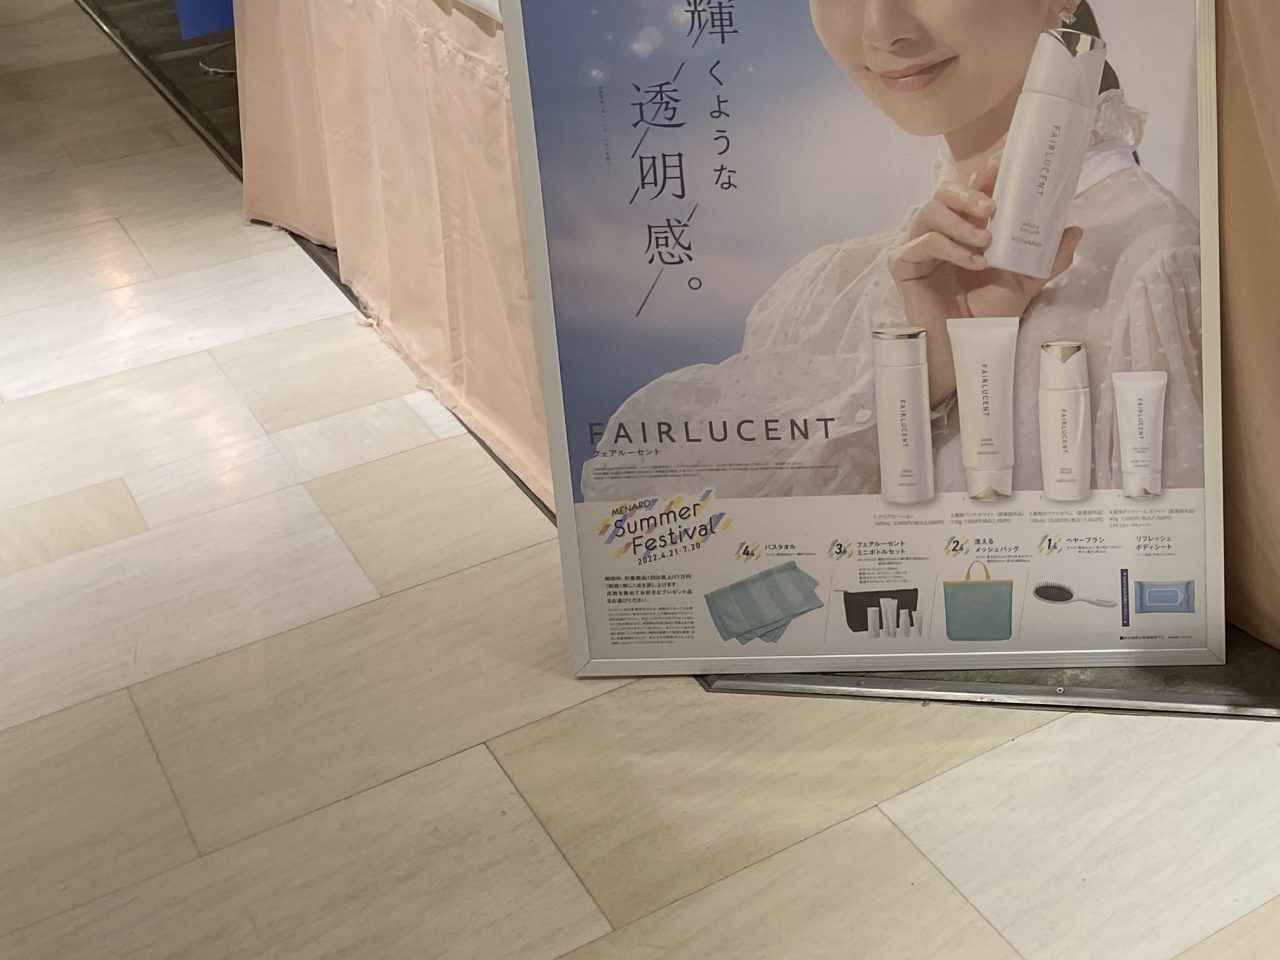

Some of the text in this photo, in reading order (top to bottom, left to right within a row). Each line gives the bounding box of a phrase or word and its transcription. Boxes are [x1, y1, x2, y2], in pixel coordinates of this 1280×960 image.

[1037, 125, 1061, 197] FAIRLUCENT
[980, 363, 991, 418] FAIRLUCENT
[588, 417, 836, 445] FAIRLUCENT
[899, 399, 910, 448] FAIRLUCENT
[1059, 408, 1069, 454] FAIRLUCENT
[611, 498, 652, 517] MENARD
[614, 503, 702, 538] Summer
[632, 516, 717, 556] Festival
[1135, 535, 1172, 543] リフレッシュ
[1135, 543, 1173, 551] ボディシート
